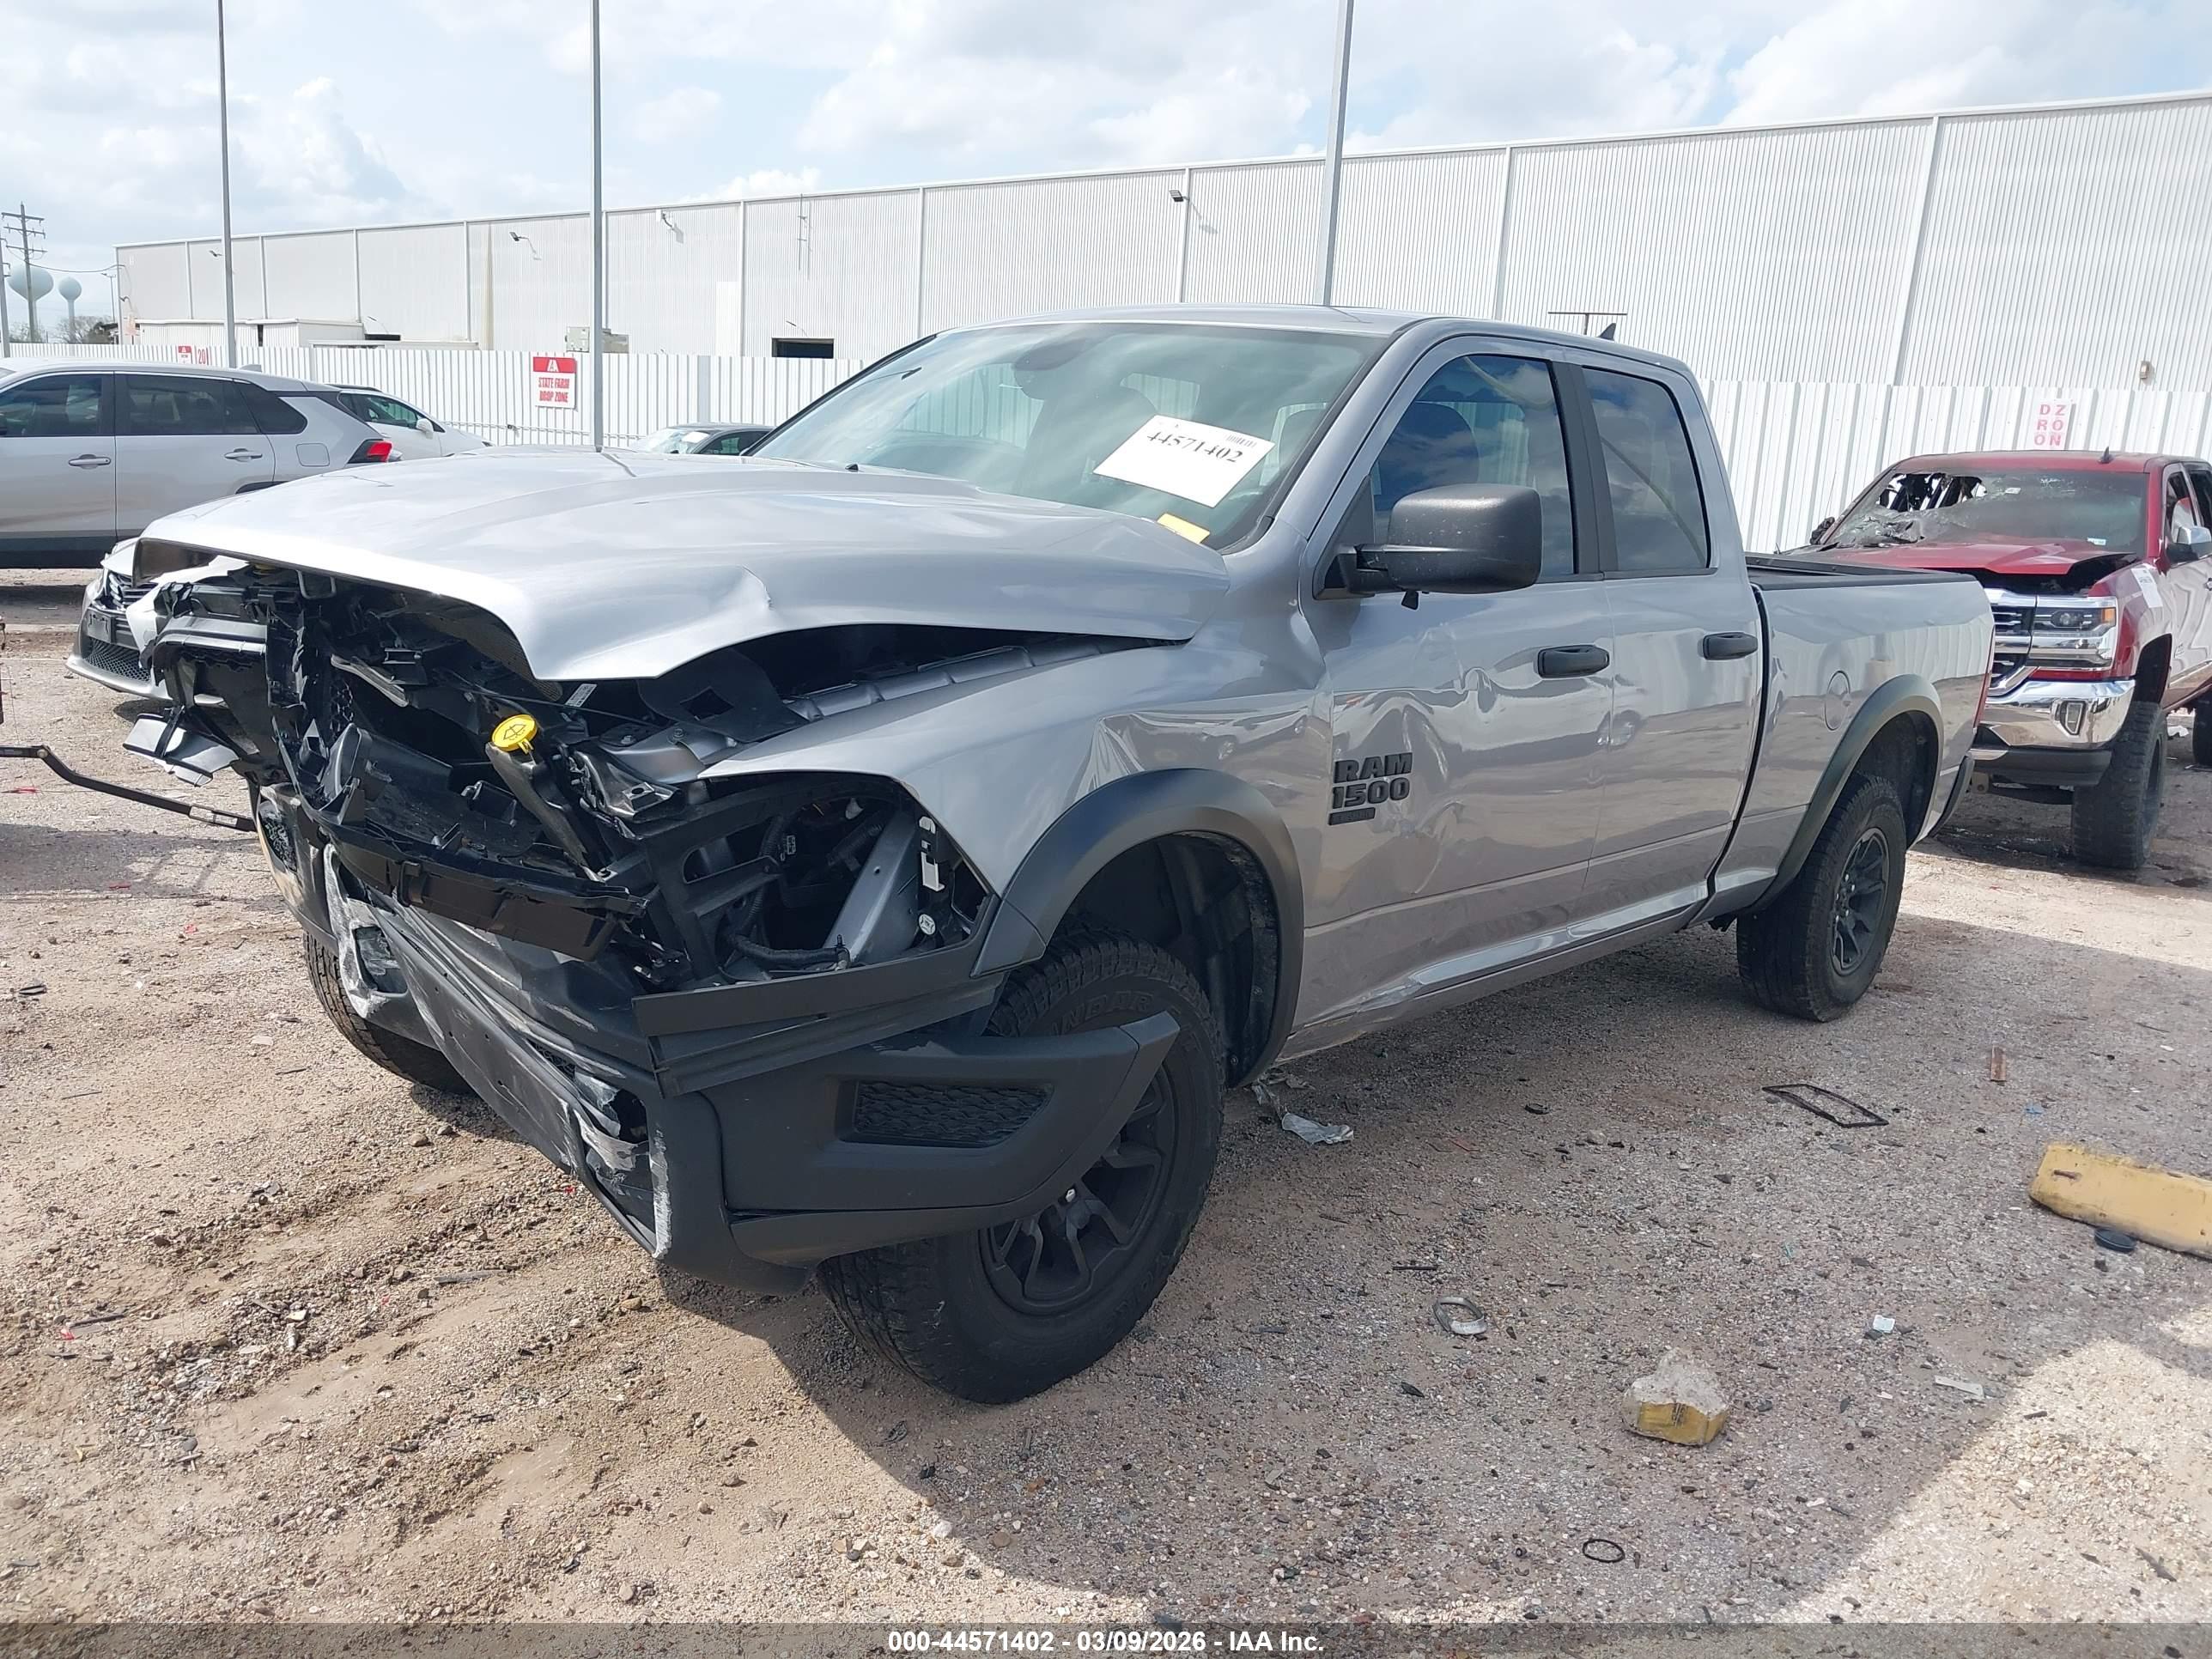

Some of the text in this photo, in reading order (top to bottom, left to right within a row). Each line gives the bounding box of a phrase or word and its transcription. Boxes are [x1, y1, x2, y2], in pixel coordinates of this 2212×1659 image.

[538, 377, 570, 389] STATE FARM
[539, 391, 568, 403] DROP ZONE
[1147, 431, 1243, 463] 44571402
[1333, 752, 1413, 783] RAM
[1331, 777, 1410, 809] 1500
